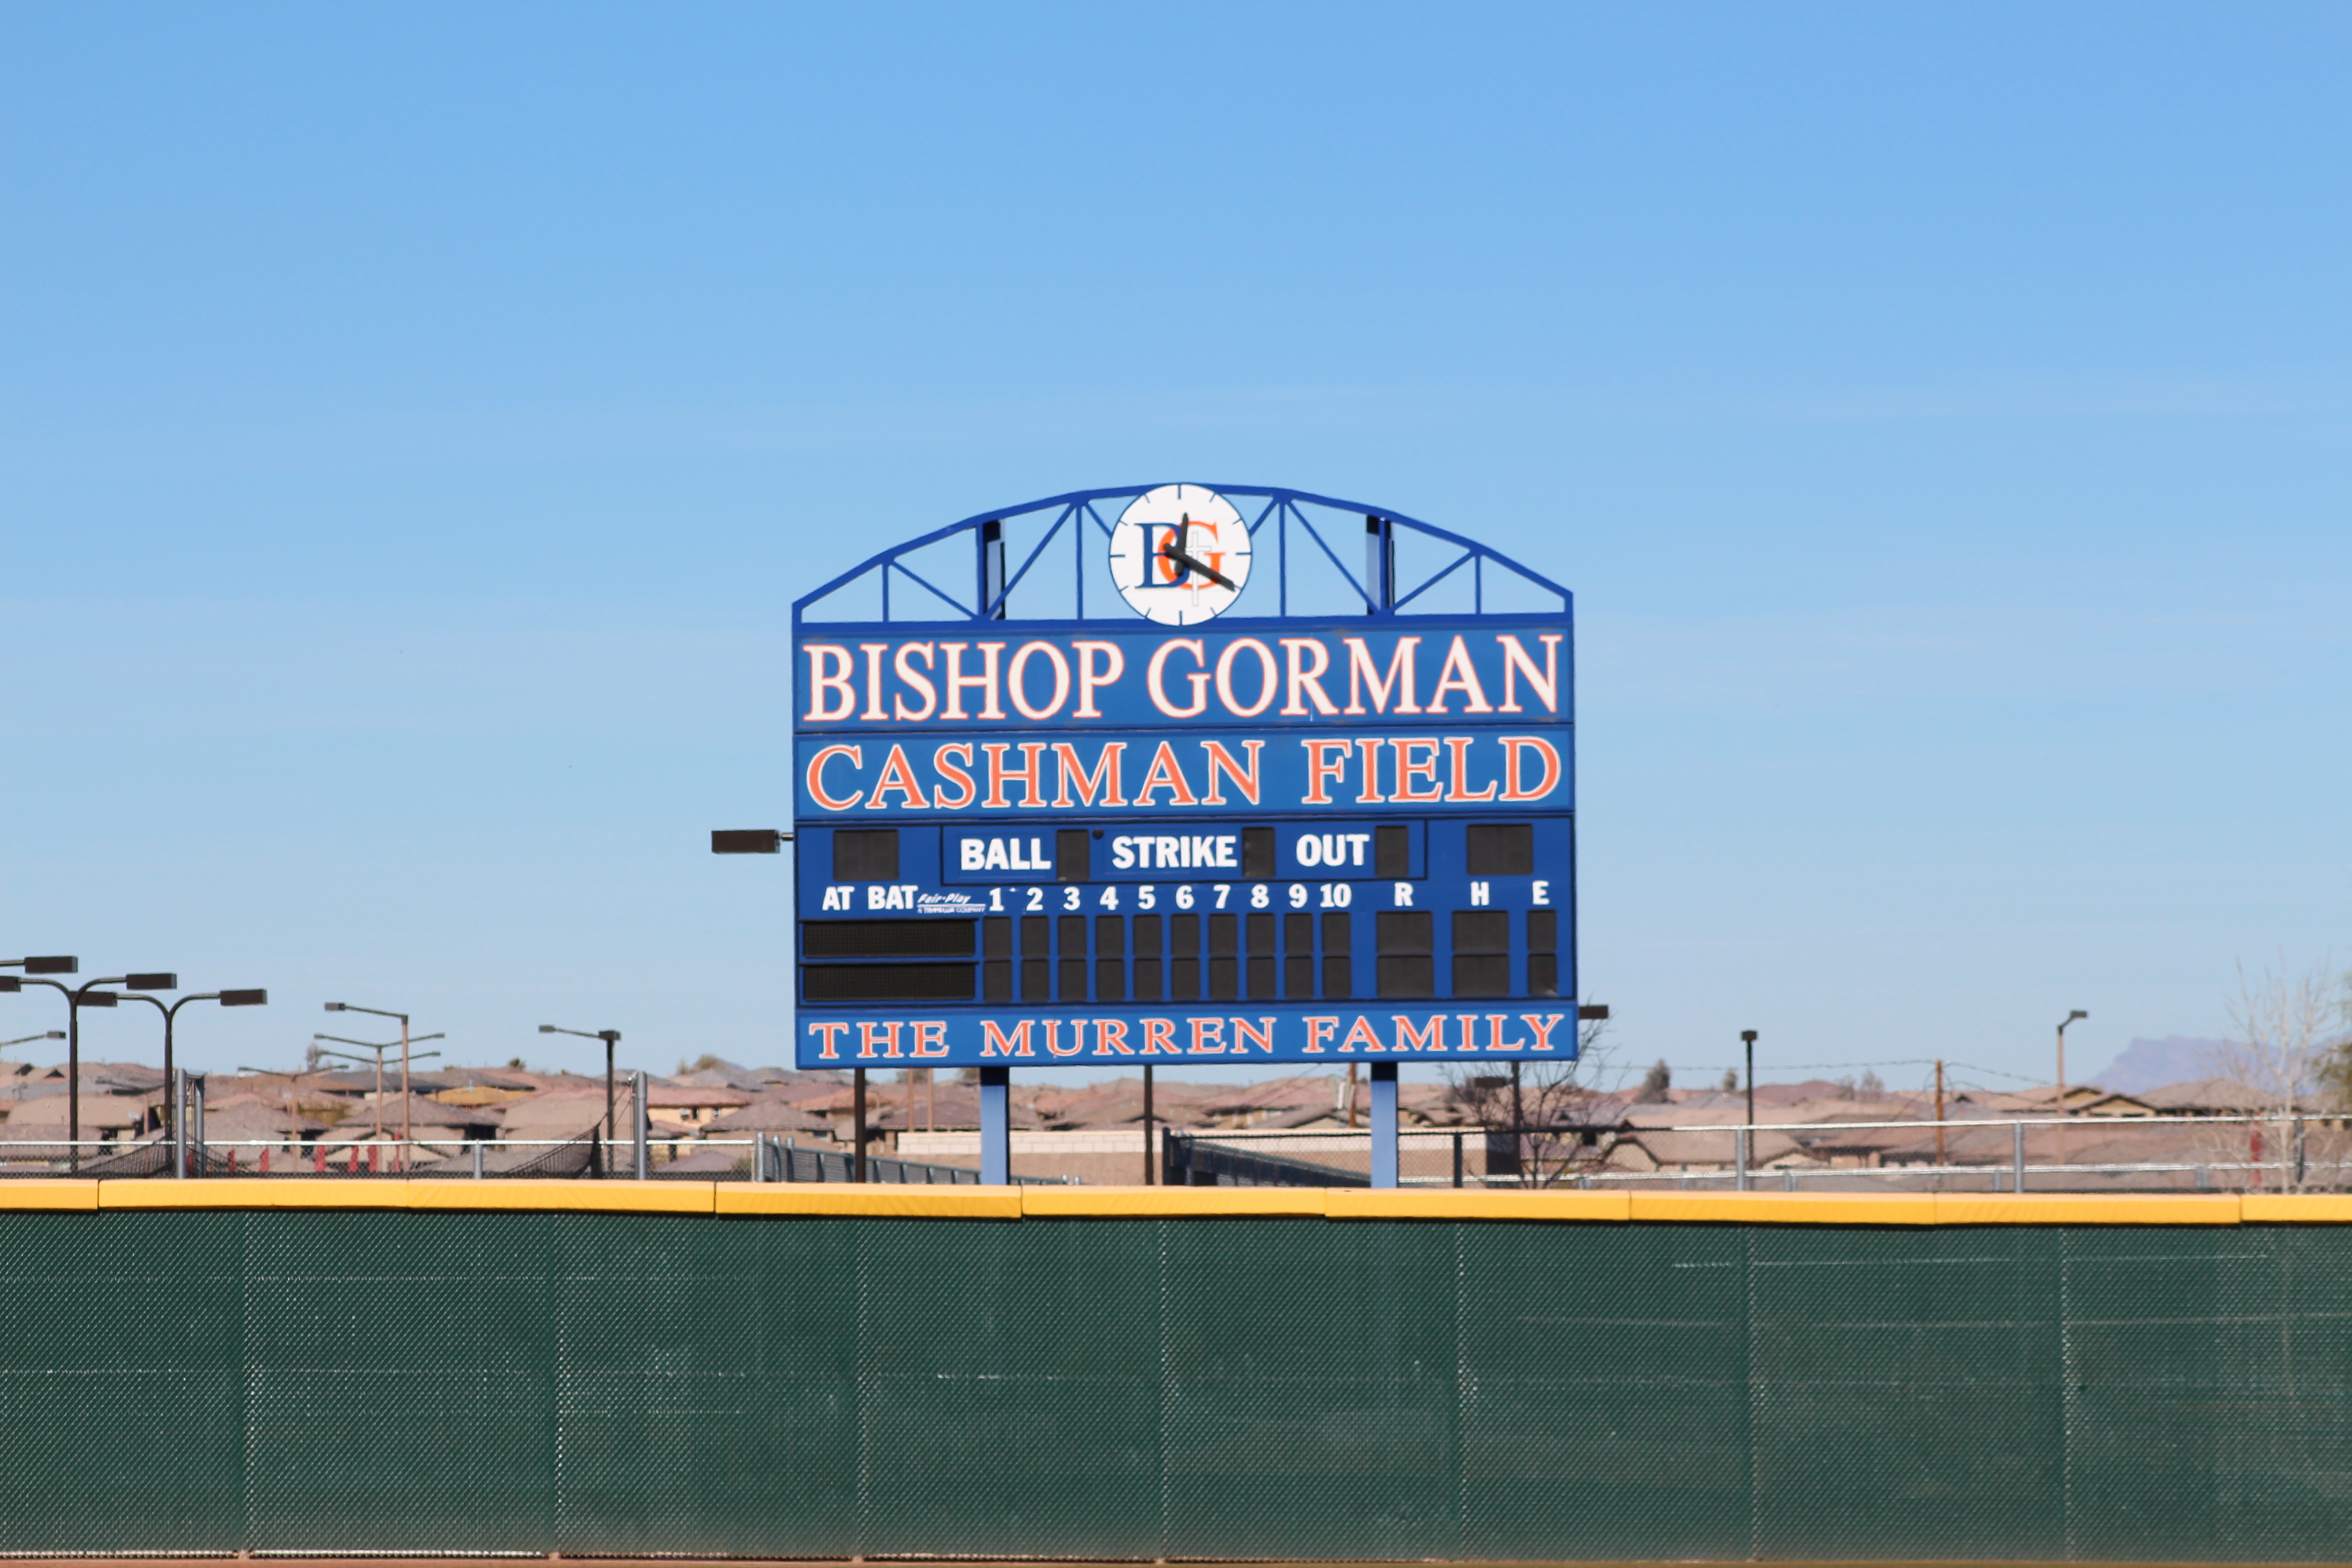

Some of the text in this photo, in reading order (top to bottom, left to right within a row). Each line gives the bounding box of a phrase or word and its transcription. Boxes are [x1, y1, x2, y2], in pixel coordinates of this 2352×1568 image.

[803, 634, 1563, 722] BISHOP GORMAN
[807, 736, 1561, 810] CASHMAN FIELD
[961, 838, 1051, 870] BALL
[1112, 836, 1237, 868] STRIKE
[1297, 834, 1369, 866] OUT
[823, 885, 918, 910] AT BAT
[990, 881, 1549, 911] 1 2 3 4 5 6 7 8 9 10 R H E
[809, 1014, 1564, 1058] THE MURREN FAMILY
